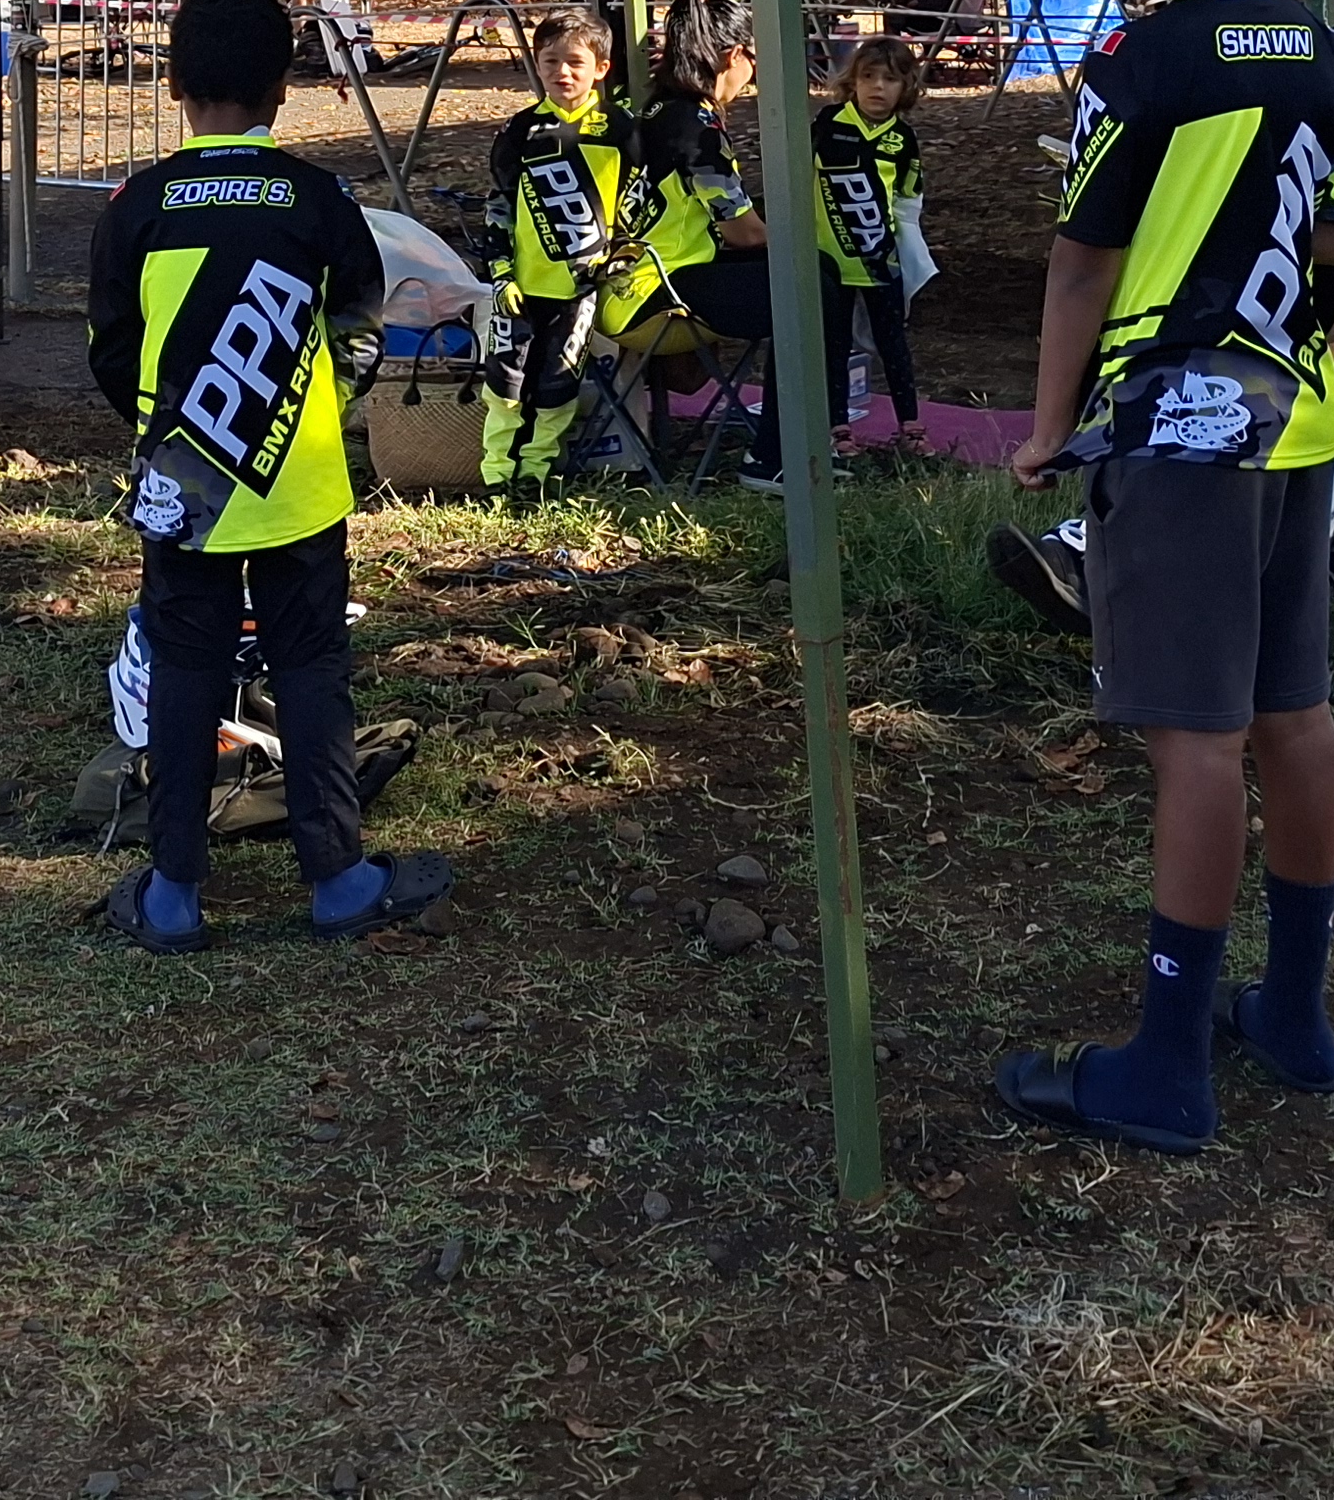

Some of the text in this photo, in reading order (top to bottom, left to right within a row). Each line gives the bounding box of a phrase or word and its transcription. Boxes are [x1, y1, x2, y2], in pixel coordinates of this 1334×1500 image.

[1221, 29, 1310, 56] SHAWN
[1083, 114, 1115, 164] RACE
[167, 180, 289, 206] ZOPIRE S.
[521, 171, 562, 255] BMX RACE
[528, 160, 601, 256] PPA
[829, 172, 886, 253] PPA
[830, 214, 856, 251] RACE
[180, 258, 314, 468] PPA
[493, 315, 514, 355] PA
[252, 323, 320, 478] BMX RAC
